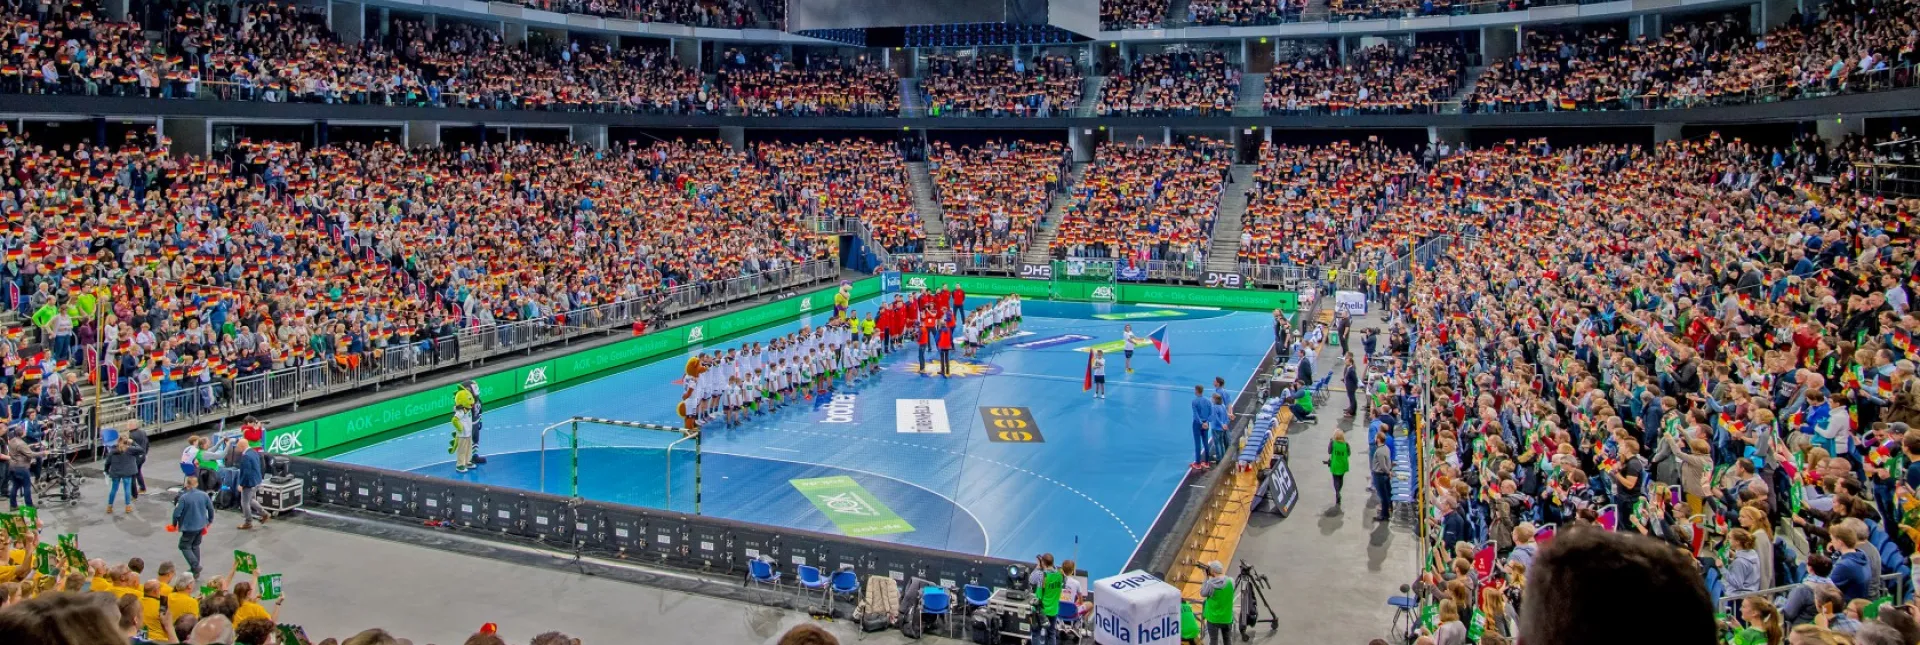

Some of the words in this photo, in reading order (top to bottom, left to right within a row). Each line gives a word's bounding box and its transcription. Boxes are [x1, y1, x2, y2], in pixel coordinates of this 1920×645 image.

[1020, 264, 1052, 276] DHB
[1205, 272, 1241, 285] DHB
[907, 276, 927, 287] AOK
[1143, 290, 1163, 299] AOK
[1171, 291, 1186, 300] Die
[525, 366, 548, 385] AOK
[346, 416, 374, 435] AOK
[383, 409, 401, 426] Die
[267, 429, 303, 453] AOK
[1094, 604, 1131, 643] hella
[1137, 616, 1179, 645] hella
